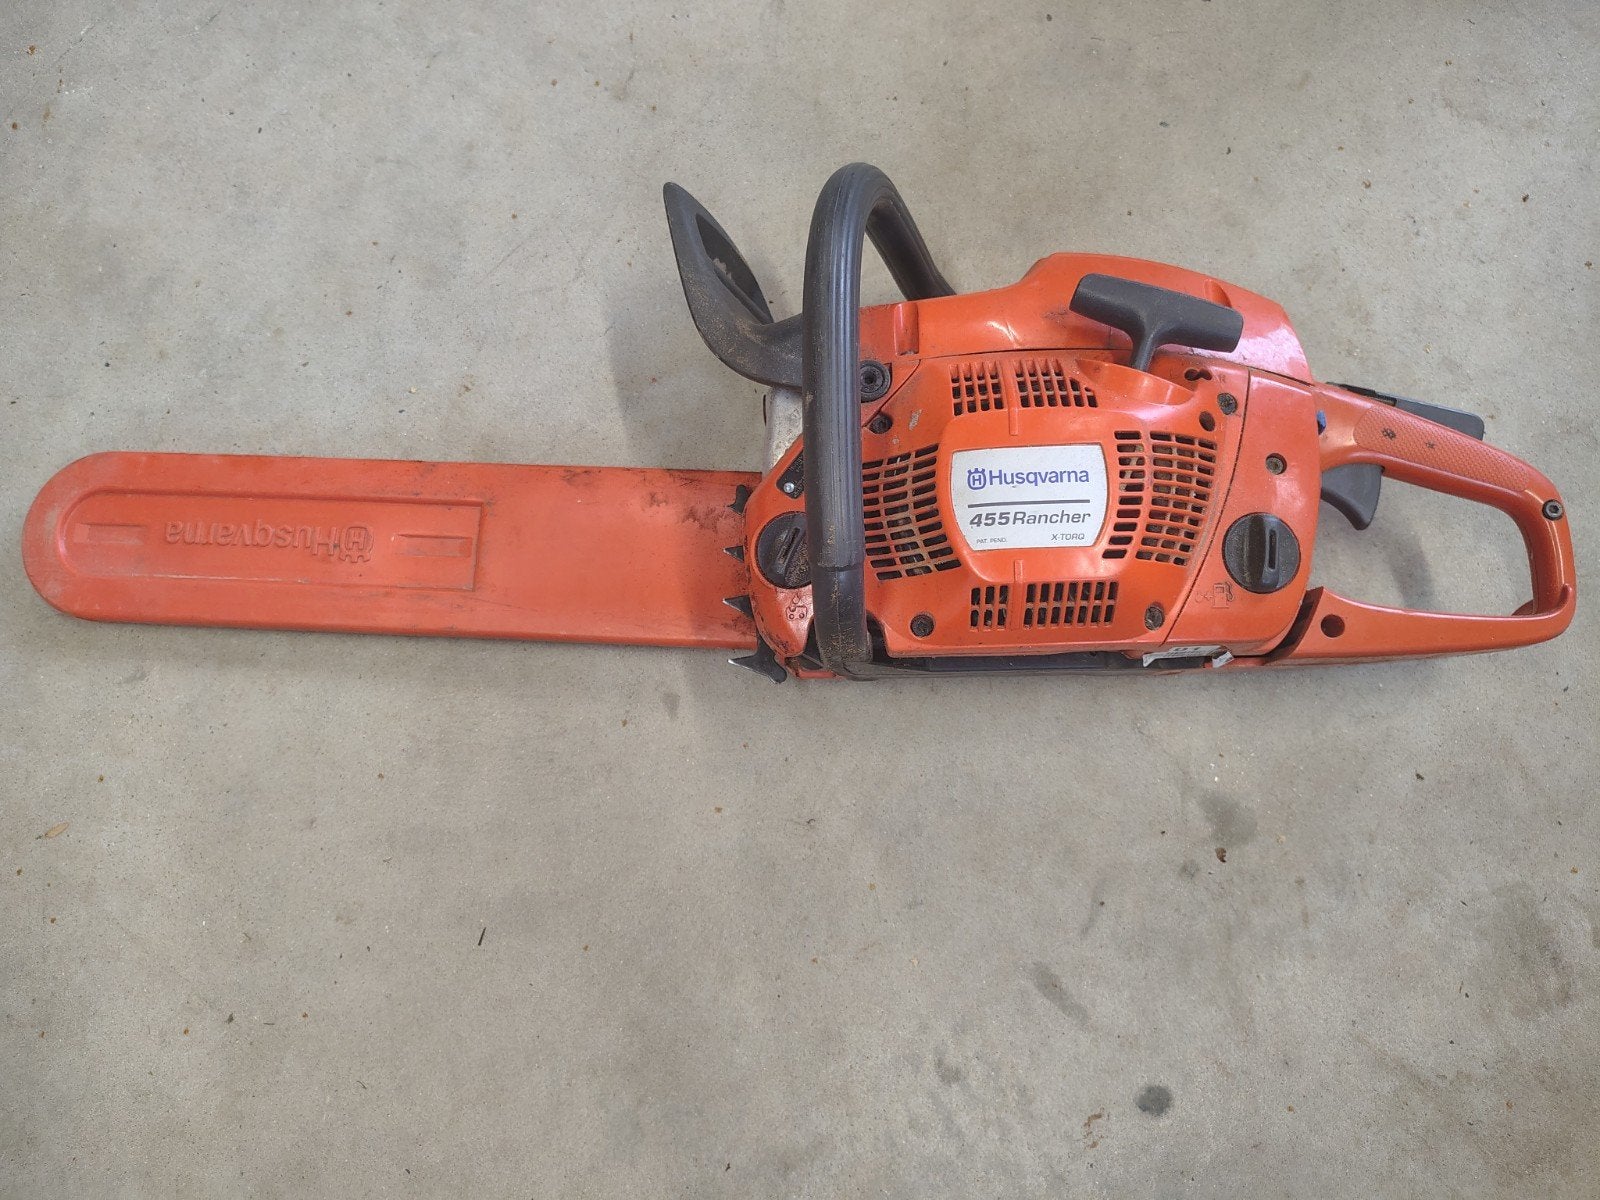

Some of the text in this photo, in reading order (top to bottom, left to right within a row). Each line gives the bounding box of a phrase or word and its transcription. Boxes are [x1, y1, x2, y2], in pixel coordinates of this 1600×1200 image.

[989, 469, 1090, 487] Husqvarna
[969, 510, 1091, 528] 455 Rancher
[164, 519, 338, 556] Husqvarna
[1051, 533, 1085, 541] X-TORQ
